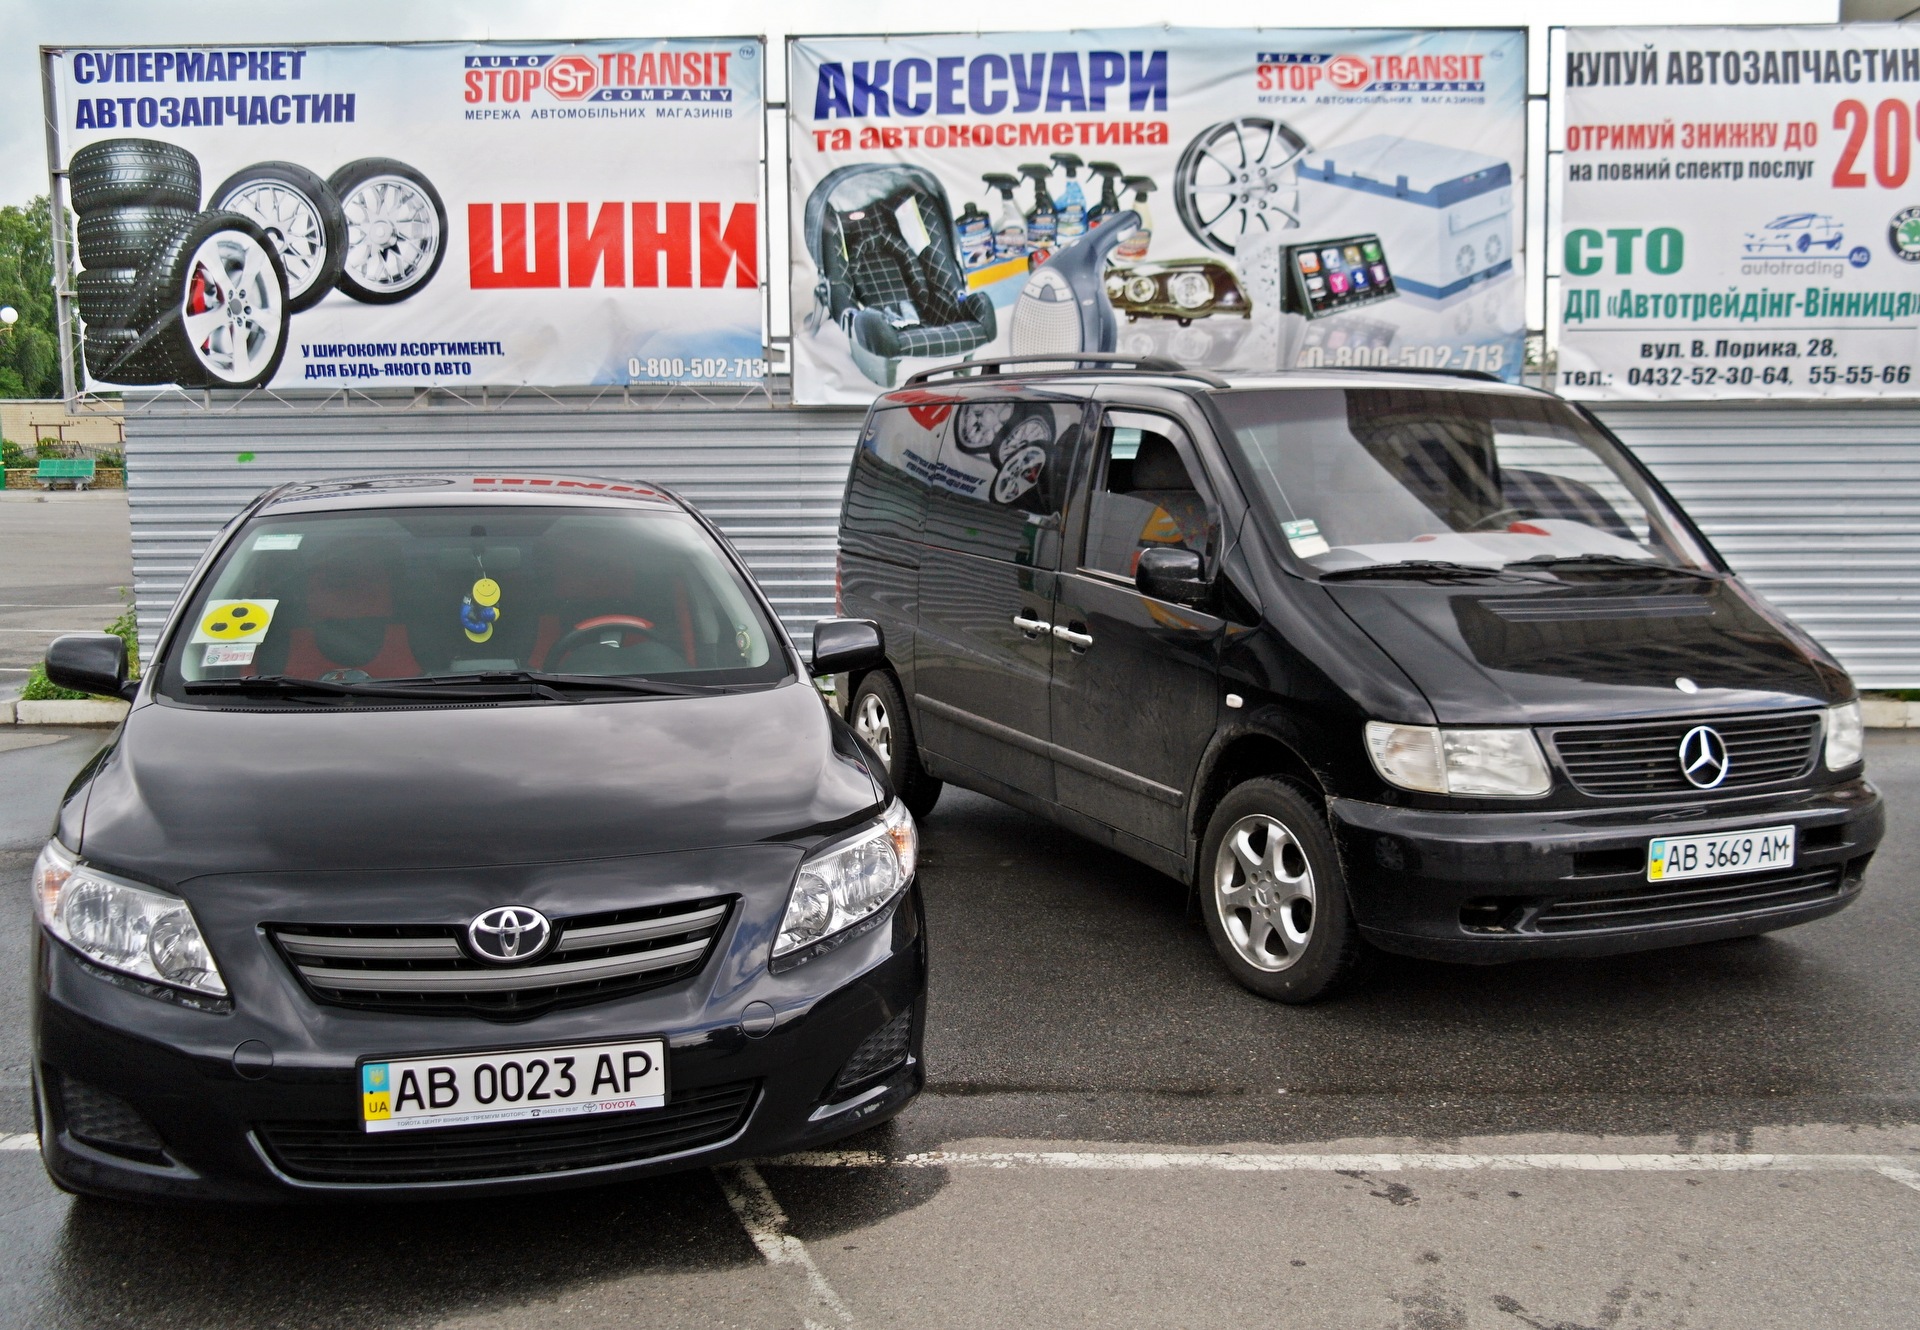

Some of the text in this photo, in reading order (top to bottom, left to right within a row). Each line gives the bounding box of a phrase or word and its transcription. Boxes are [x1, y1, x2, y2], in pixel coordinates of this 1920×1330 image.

[73, 50, 306, 84] СУПЕРМАРКЕТ
[471, 56, 539, 67] AUTO
[598, 53, 732, 87] TRANSIT
[1262, 54, 1321, 63] AUTO
[1371, 55, 1484, 80] TRANSIT
[1566, 44, 1920, 87] КУПУЙ АВТОЗАПЧАСТИН
[464, 70, 541, 103] STOP
[814, 50, 1168, 121] АКСЕСУАРИ
[1257, 65, 1322, 91] STOP
[1374, 83, 1484, 91] COMPANY
[602, 89, 731, 101] COMPANY
[1258, 95, 1307, 104] МЕРЕЖА
[75, 93, 356, 129] АВТОЗАПЧАСТИН
[465, 108, 733, 120] МЕРЕЖА АВТОМОБІЛЬНИХ МАГАЗИНІВ
[813, 121, 1168, 152] та автокосметика
[1567, 119, 1818, 151] ОТРИМУЙ ЗНИЖКУ ДО
[1831, 98, 1920, 190] 20
[1569, 157, 1815, 181] на повний спектр послуг
[468, 201, 758, 289] ШИНИ
[1564, 227, 1684, 276] СТО
[1741, 260, 1844, 279] autotrading
[1564, 289, 1600, 324] ДП
[301, 341, 505, 358] У ШИРОКОМУ АСОРТИМЕНТІ,
[1306, 345, 1505, 371] 0-800-502-713
[1640, 338, 1838, 360] вул. В. Порика, 28,
[305, 361, 472, 379] ДЛЯ БУДЬ-ЯКОГО АВТО
[628, 357, 764, 378] 0-800-502-713
[1563, 365, 1911, 386] тел.: 0432-52-30-64, 55-55-66
[1666, 844, 1698, 872] AB
[1705, 838, 1752, 868] 3669
[395, 1050, 652, 1112] AB 0023 AP
[369, 1102, 388, 1114] UA
[599, 1100, 636, 1110] TOYOTA
